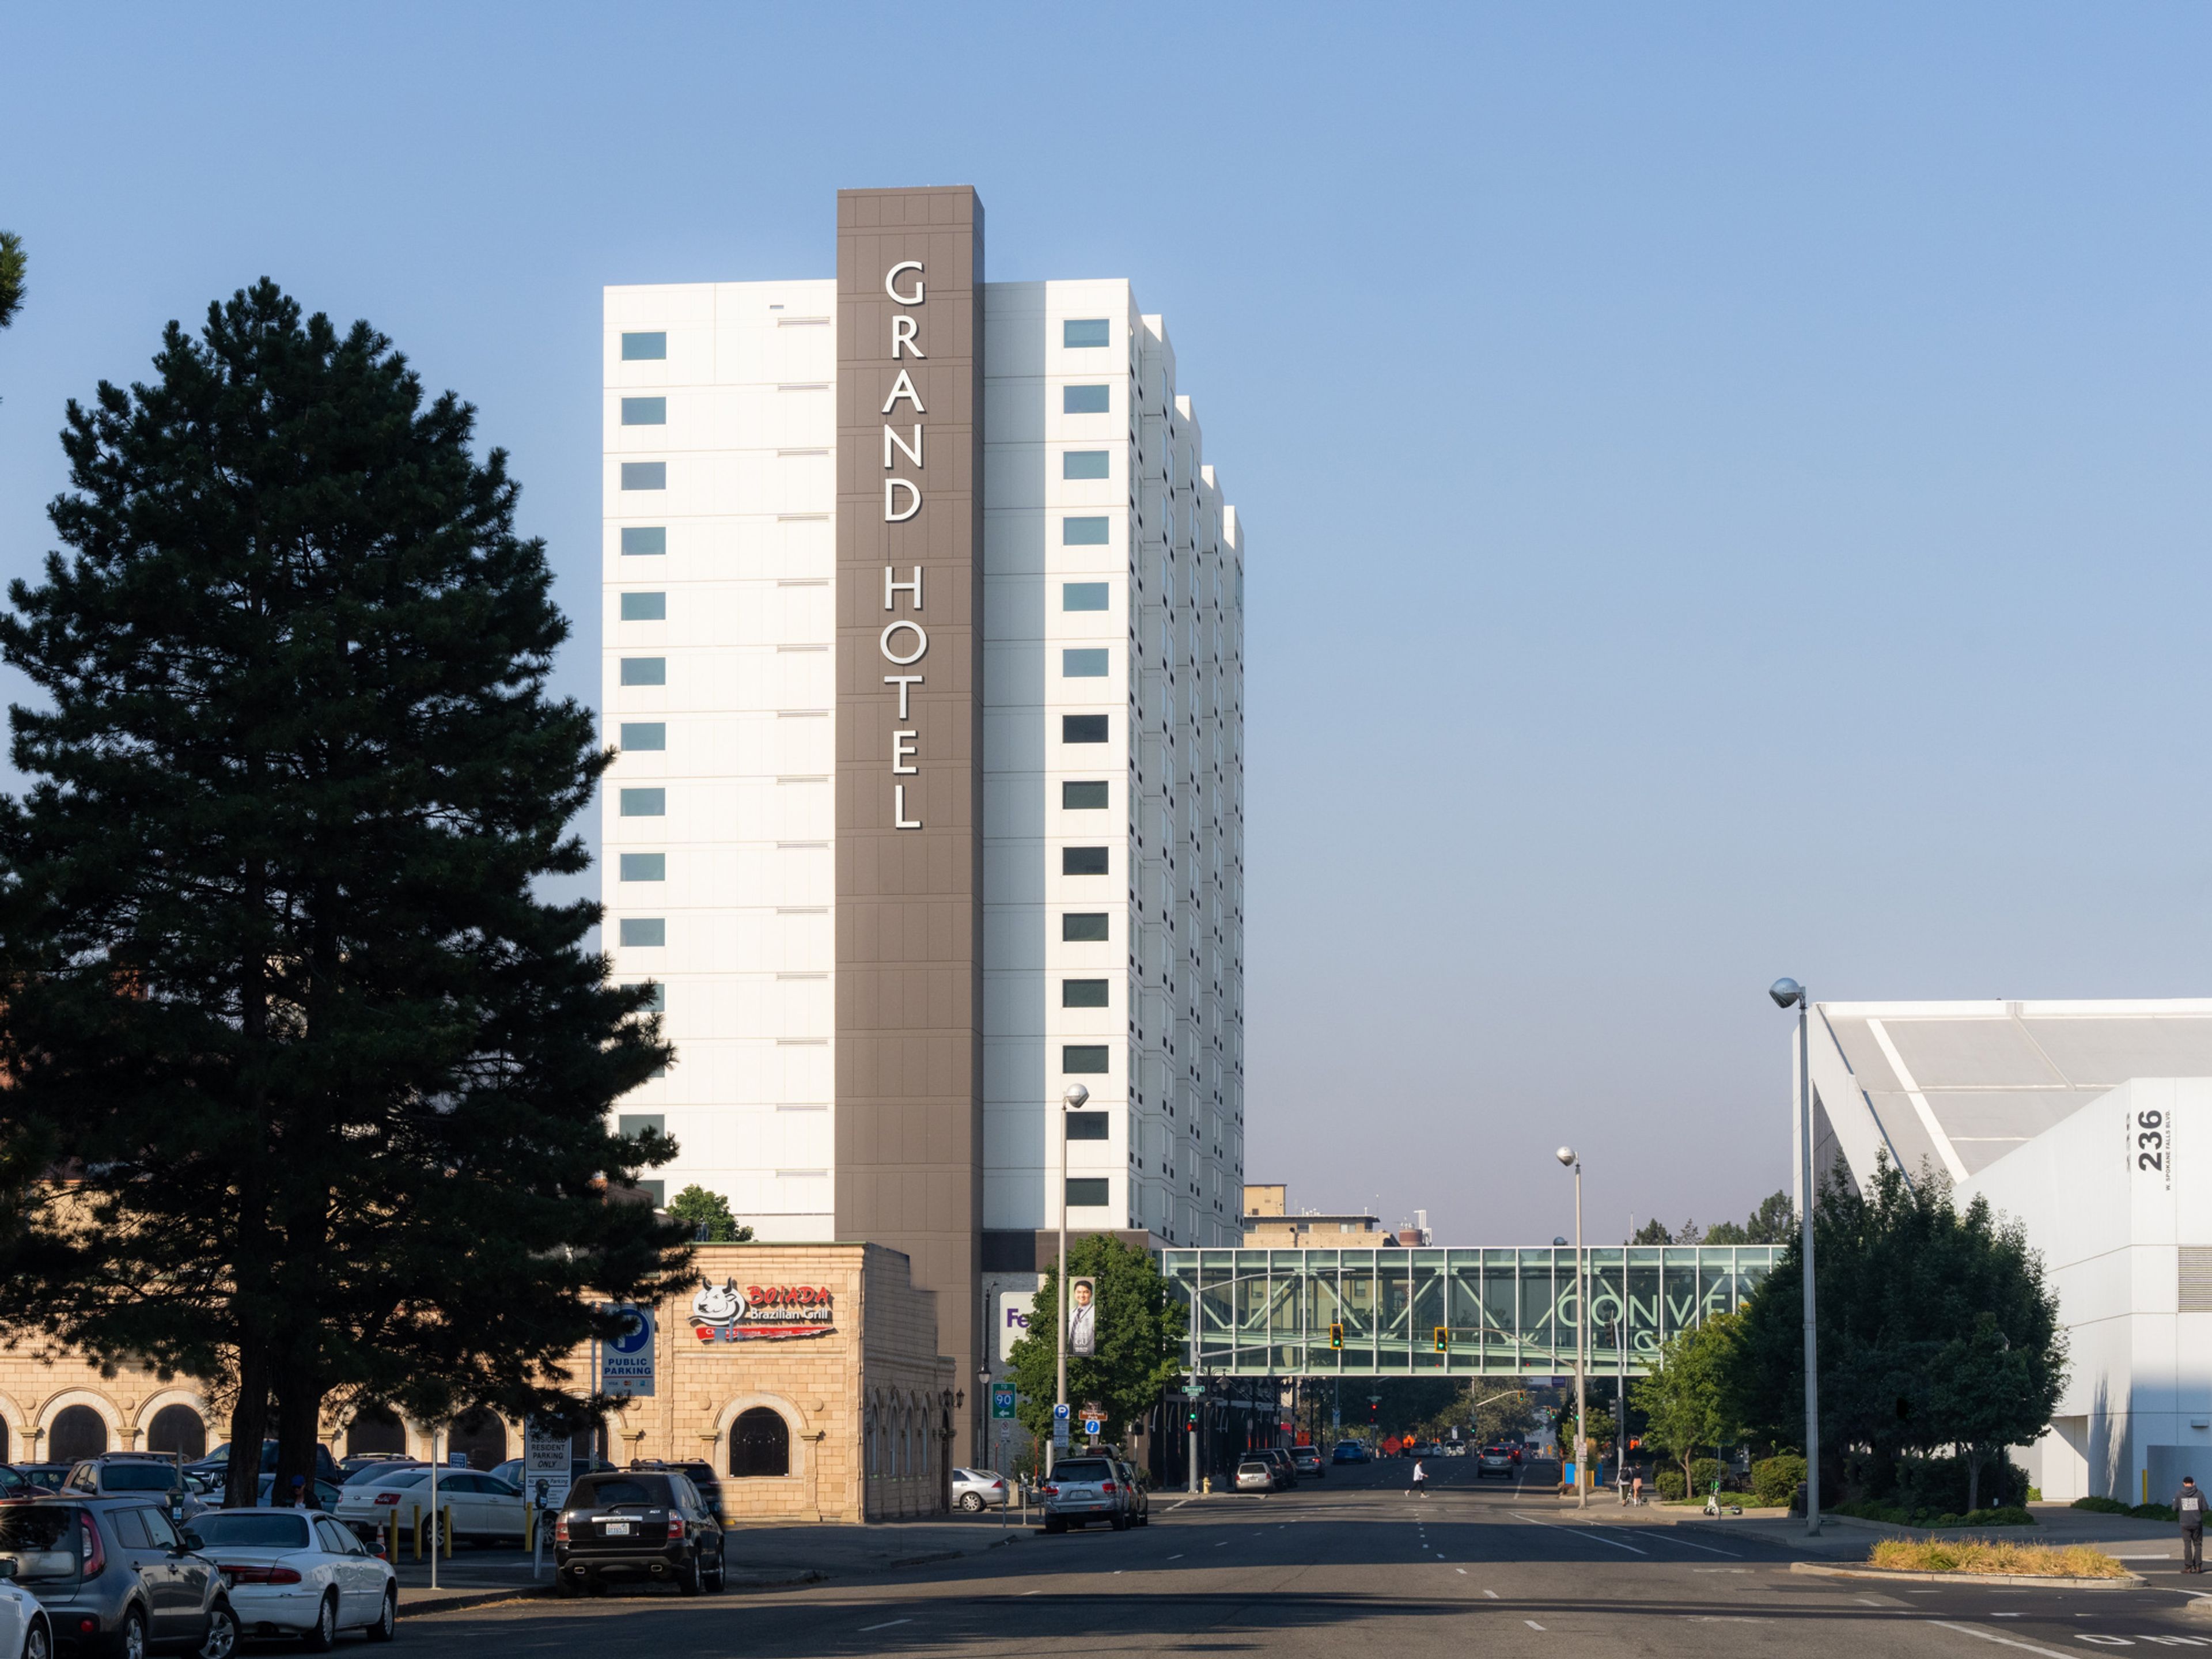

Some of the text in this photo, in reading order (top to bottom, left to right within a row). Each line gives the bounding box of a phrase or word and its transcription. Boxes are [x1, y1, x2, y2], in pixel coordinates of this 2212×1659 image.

[880, 261, 927, 828] GRAND HOTEL
[2138, 1110, 2162, 1171] 236
[751, 1308, 828, 1320] Brazilian Grill
[996, 1395, 1012, 1404] 90
